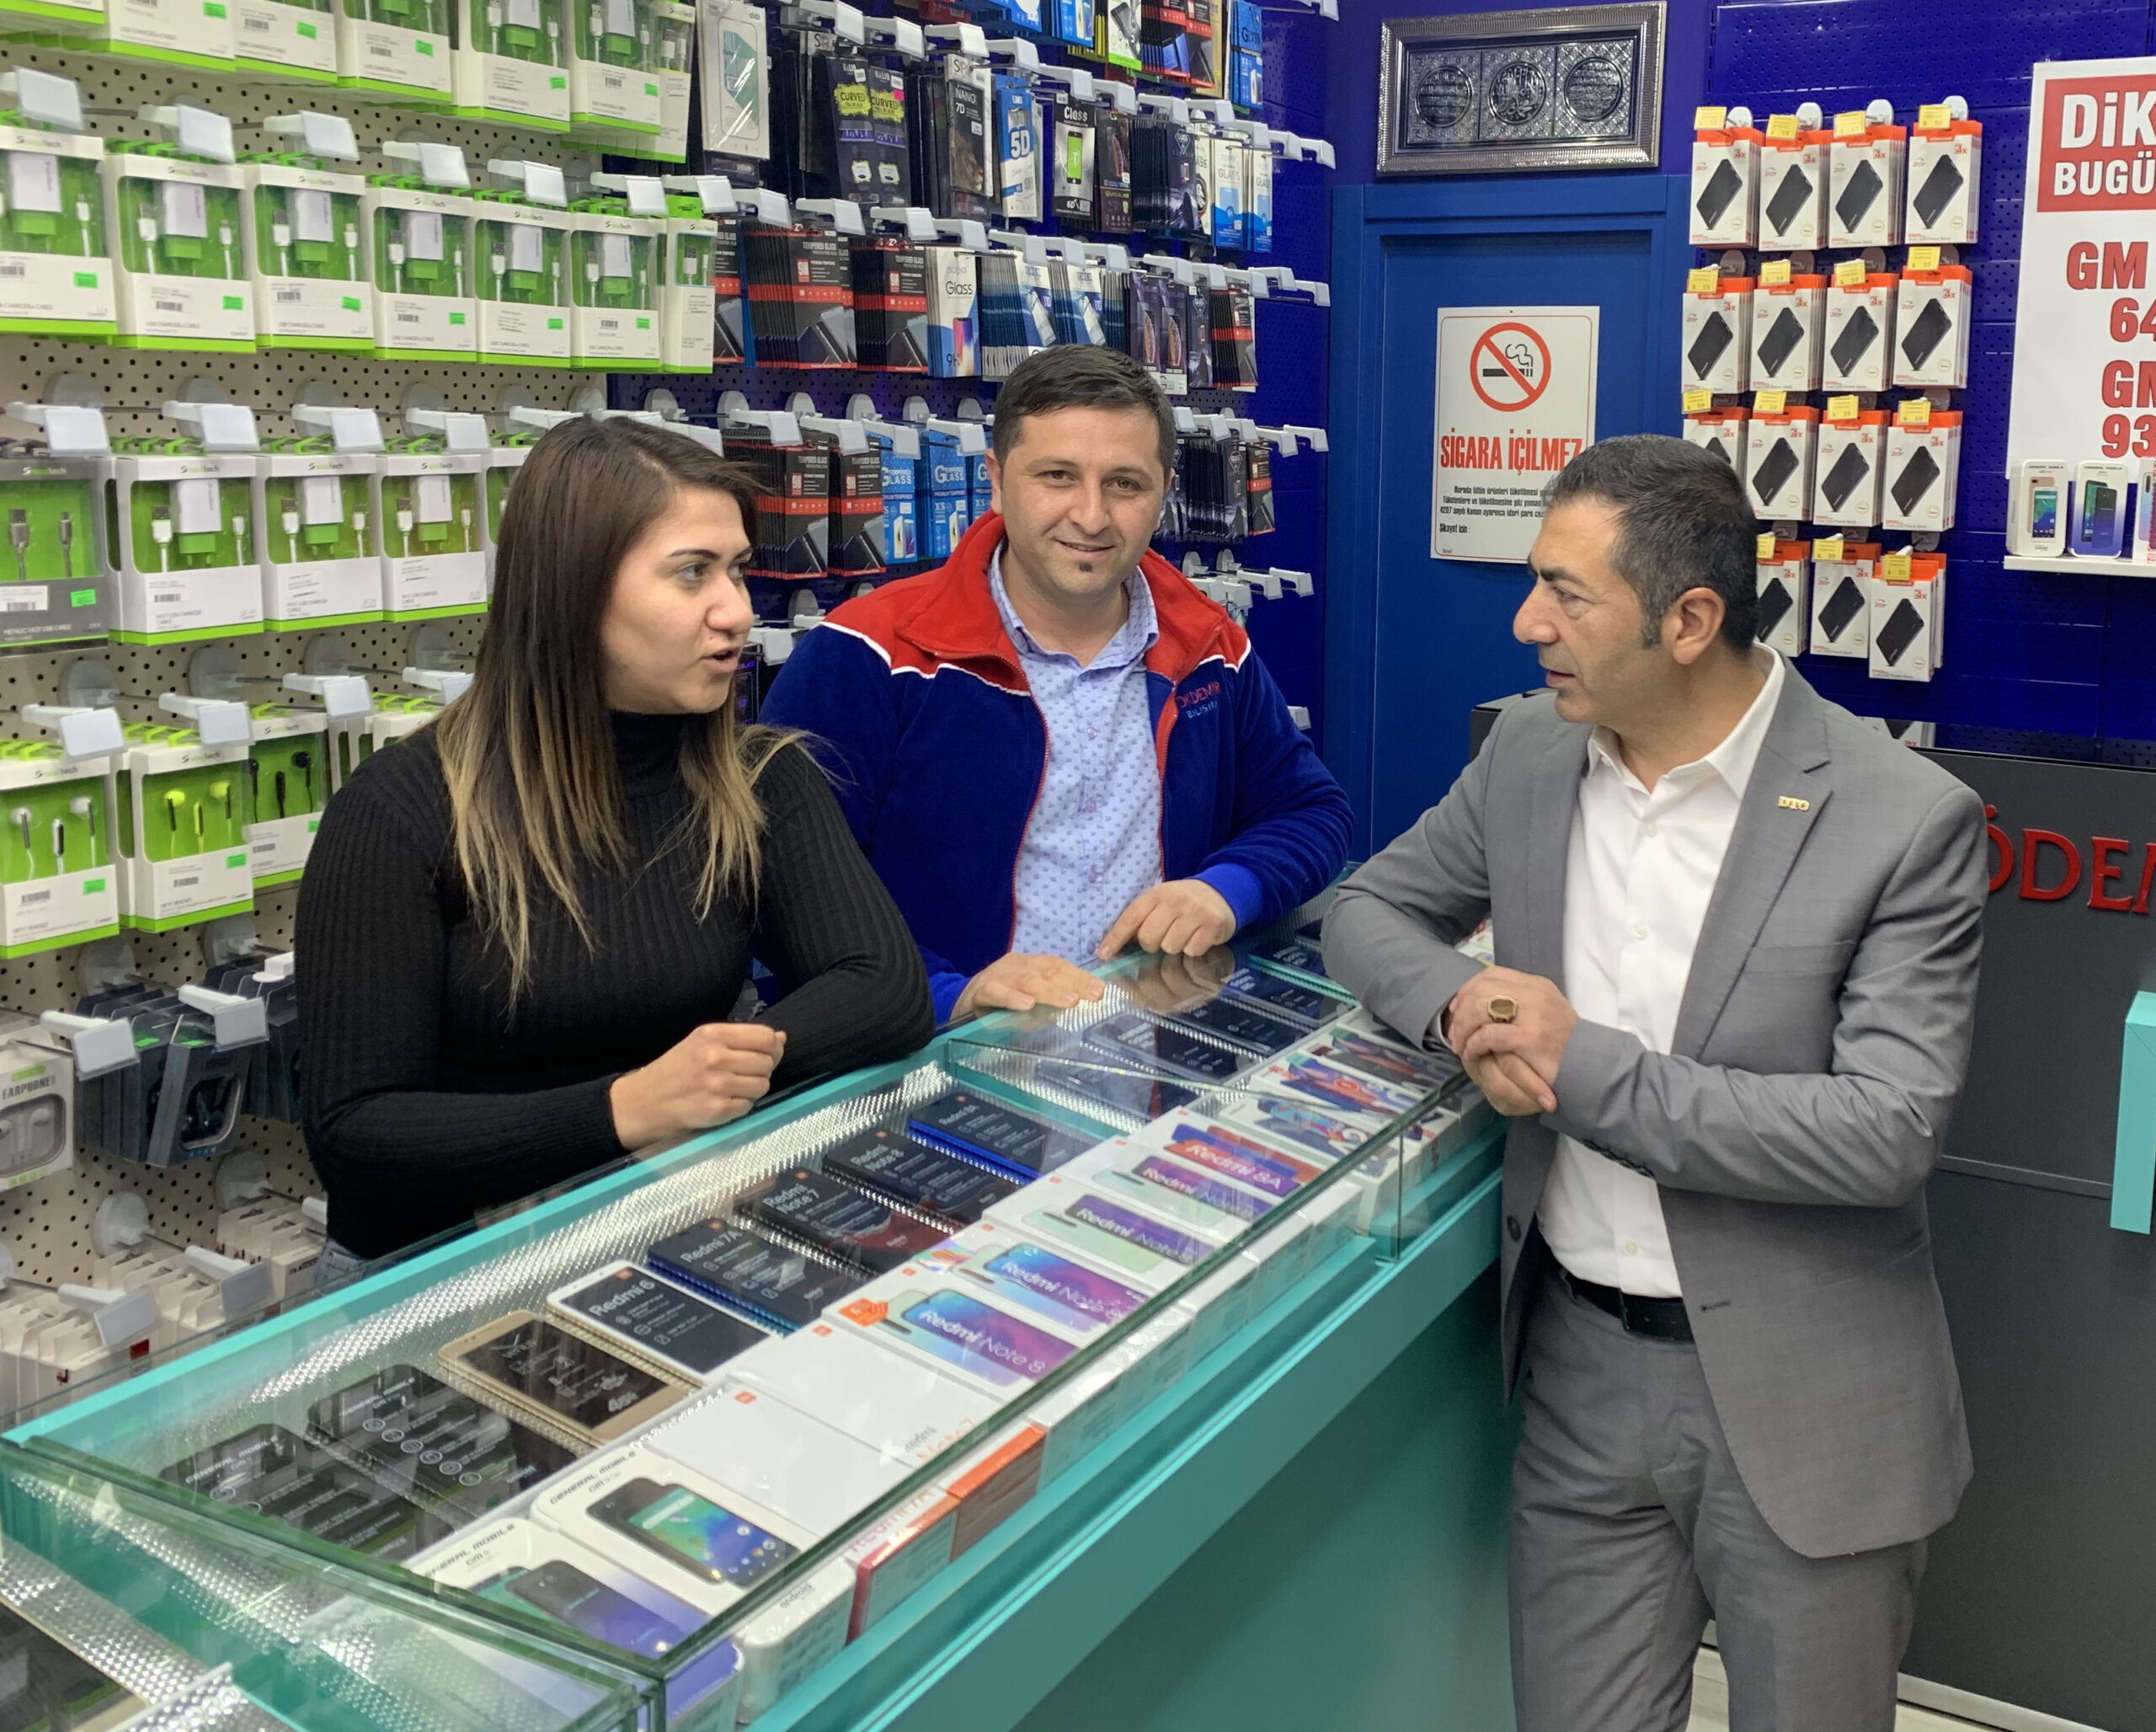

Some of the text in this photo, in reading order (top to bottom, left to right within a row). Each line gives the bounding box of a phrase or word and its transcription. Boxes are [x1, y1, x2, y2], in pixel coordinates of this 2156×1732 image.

[840, 91, 866, 102] CURVED
[871, 95, 899, 110] CURVED
[955, 87, 976, 104] NANO
[1011, 129, 1030, 158] 5D
[1218, 168, 1241, 181] GLASS
[2053, 150, 2156, 196] BUGÜ
[2066, 241, 2149, 290] GM
[945, 281, 973, 296] Glass
[1440, 427, 1582, 475] SİGARA İÇİLMEZ
[934, 464, 964, 484] GLASS
[849, 1142, 889, 1166] Redmi
[863, 1152, 896, 1173] Note
[1186, 1144, 1283, 1190] Redmi 8A
[762, 1183, 808, 1208] Redmi
[1142, 1166, 1198, 1196] Redmi
[776, 1188, 820, 1214] Note 7
[680, 1229, 743, 1264] Redmi 7A
[1076, 1206, 1135, 1238] Redmi
[1135, 1231, 1177, 1260] Note
[589, 1279, 656, 1317] Redmi 6
[1001, 1259, 1061, 1294] Redmi
[1058, 1284, 1103, 1314] Note
[918, 1309, 1047, 1374] Redmi Note 8
[238, 1435, 279, 1458] MOBILE
[550, 1451, 637, 1505] GENERAL MOBILE
[472, 1522, 517, 1552] MOBILE
[780, 1583, 814, 1610] android
